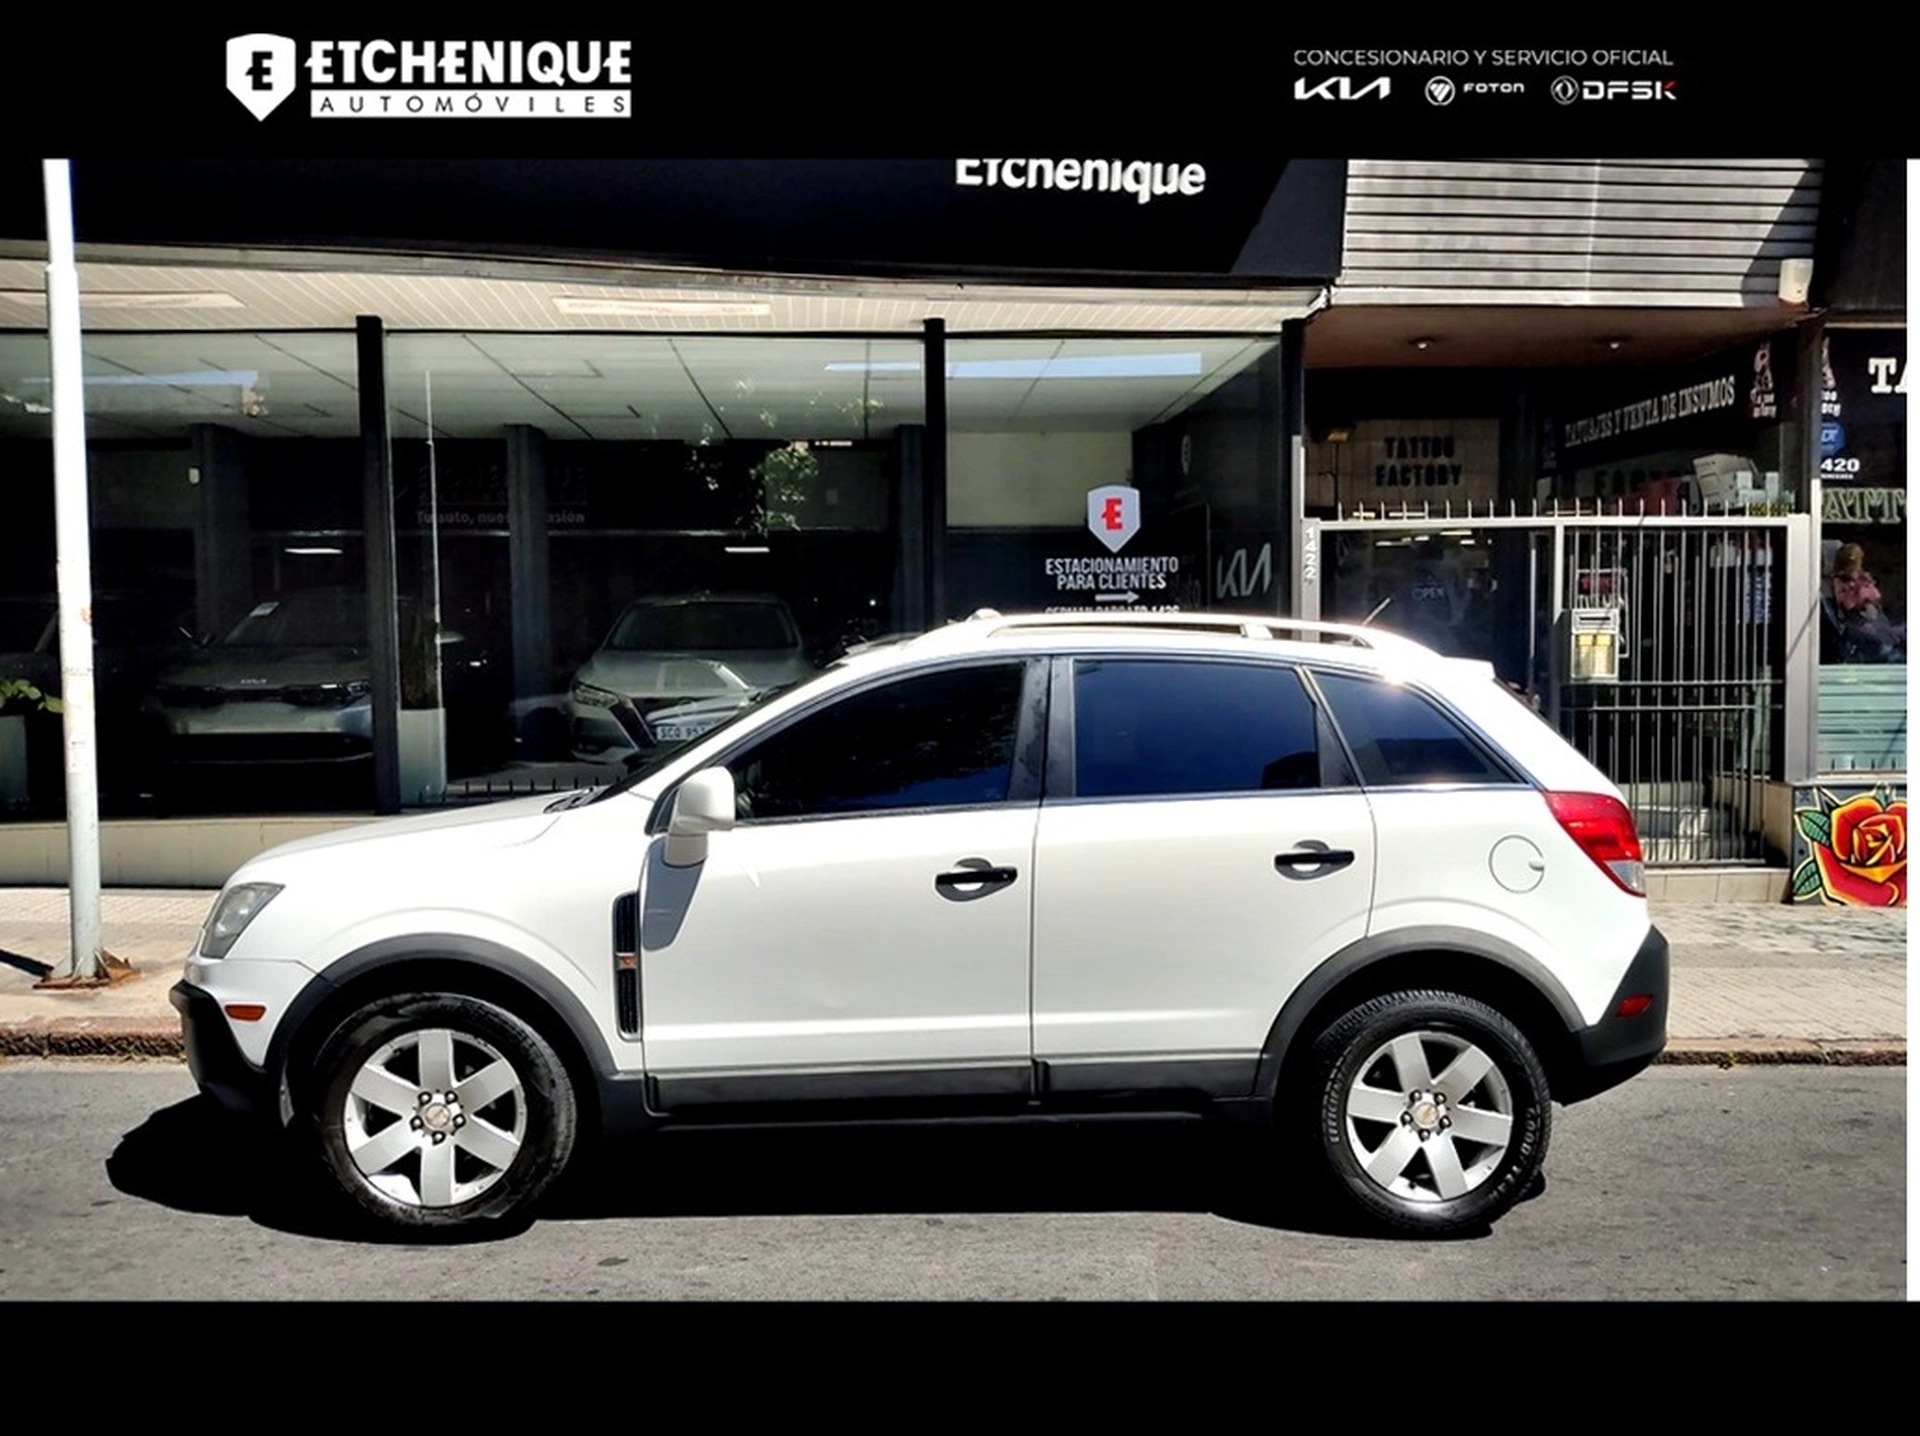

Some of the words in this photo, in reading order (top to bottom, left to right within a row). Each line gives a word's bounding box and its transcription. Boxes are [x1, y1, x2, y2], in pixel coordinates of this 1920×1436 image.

[1375, 464, 1463, 487] FACTORY
[1045, 556, 1180, 576] ESTACIONAMIENTO
[1056, 573, 1096, 591] PARA
[1099, 572, 1168, 590] CLIENTES
